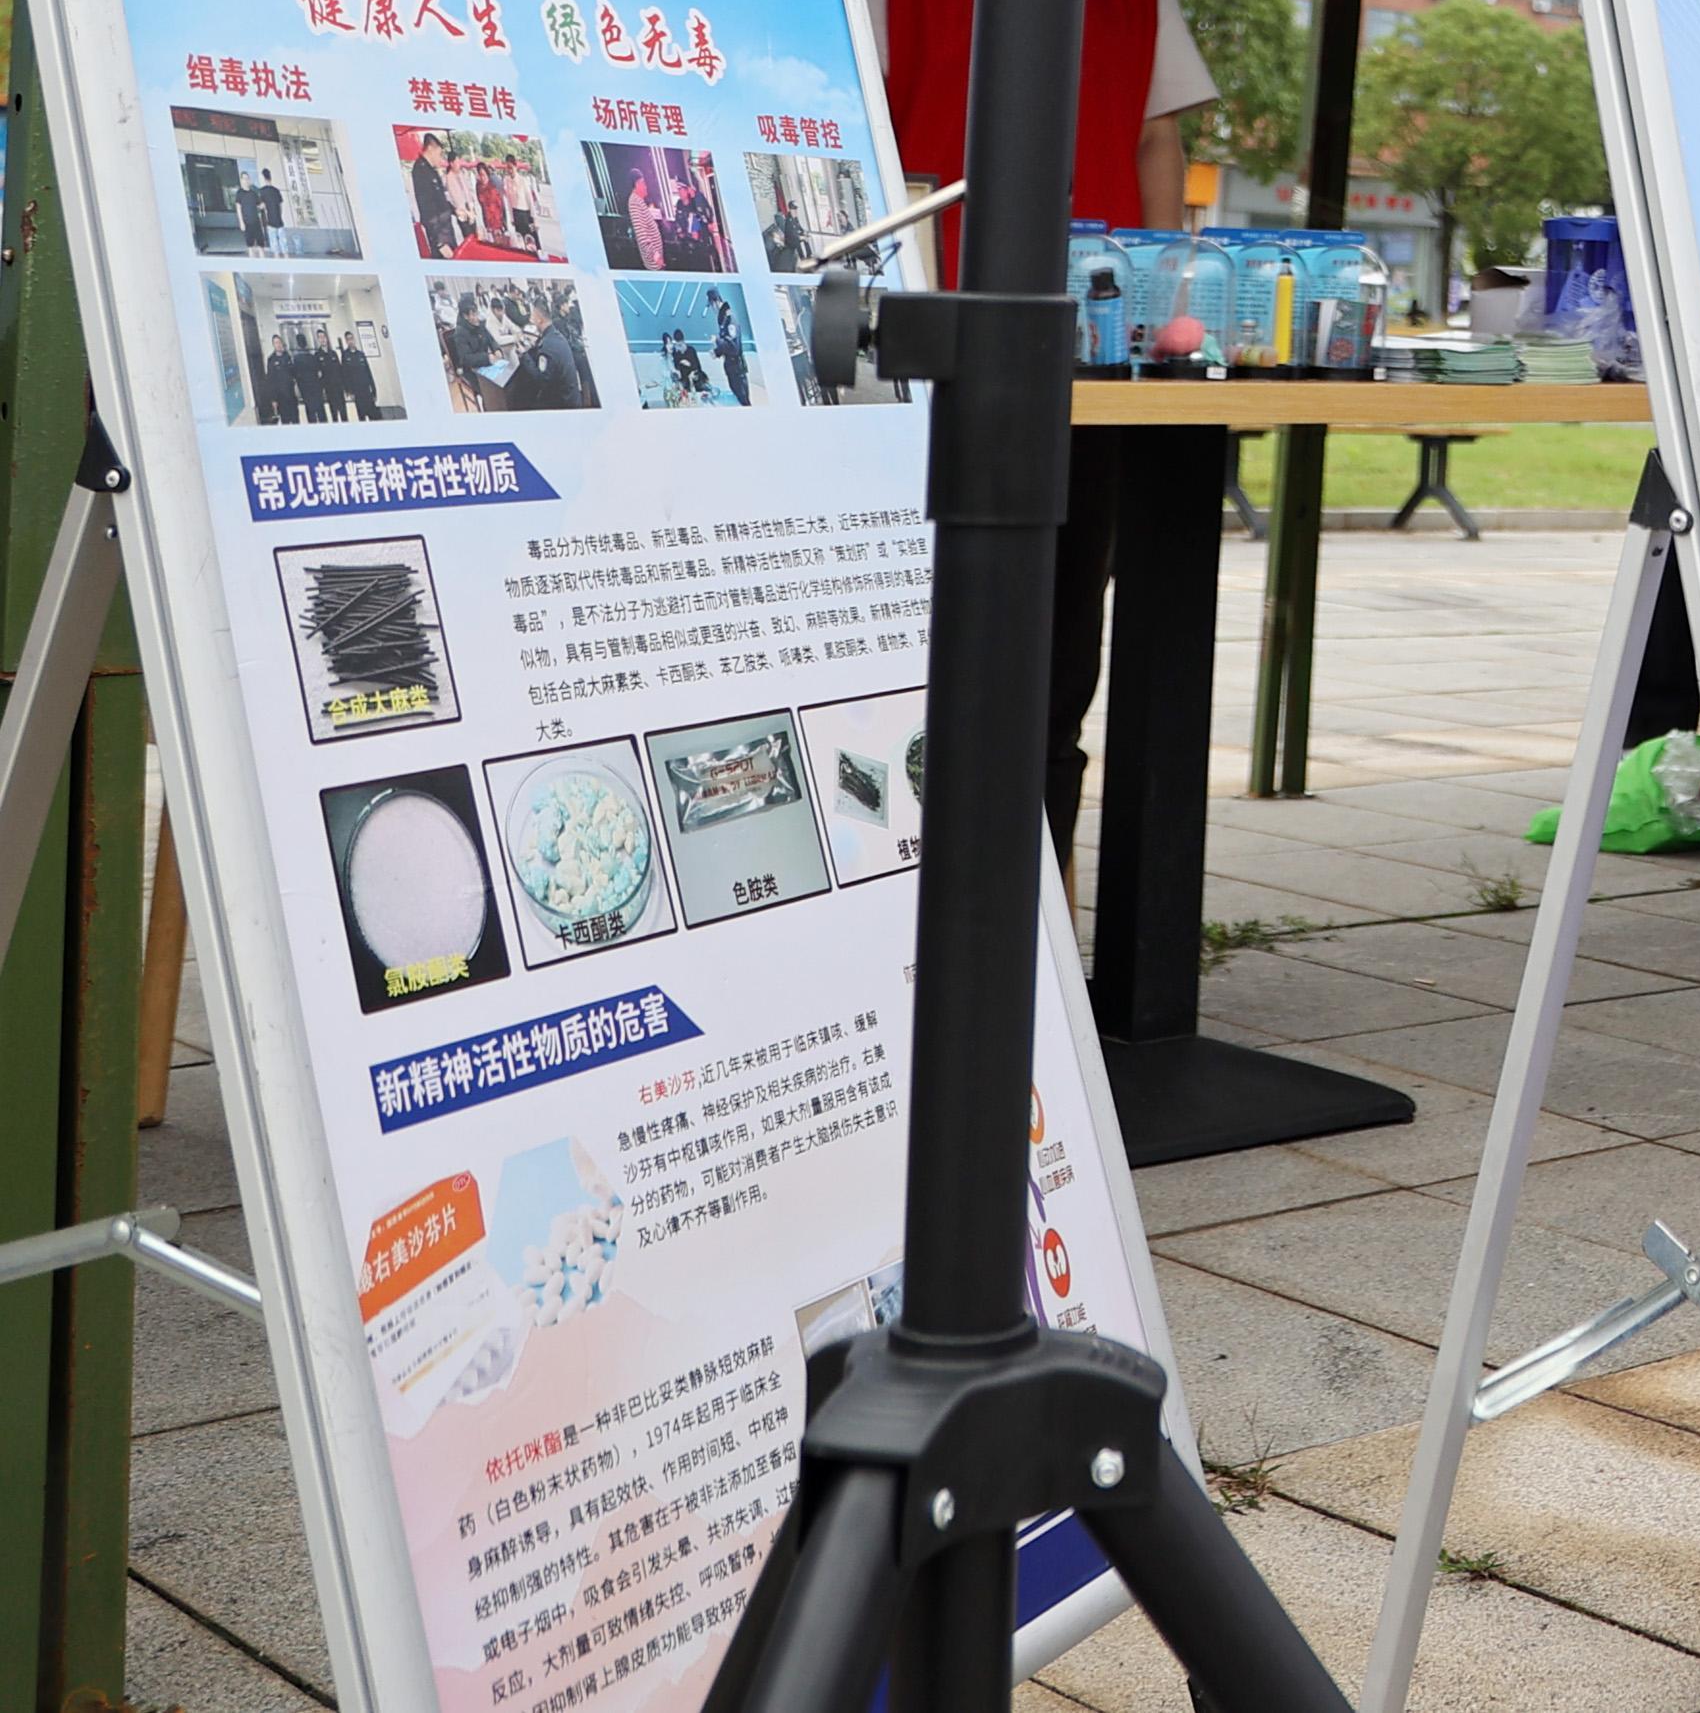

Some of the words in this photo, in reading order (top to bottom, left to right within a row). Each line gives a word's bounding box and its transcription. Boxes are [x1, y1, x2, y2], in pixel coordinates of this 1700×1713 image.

[186, 53, 312, 103] 缉毒执法
[409, 77, 518, 122] 禁毒宣传
[592, 95, 689, 139] 场所管理
[756, 114, 844, 152] 吸毒管控
[251, 452, 521, 512] 常见新精神活性物质
[328, 685, 431, 726] 合成大麻类
[732, 873, 779, 906] 色胺类
[554, 911, 628, 949] 卡西酮类
[383, 954, 470, 998] 氯胺酮类
[375, 992, 672, 1118] 新精神活性物质的危害
[617, 1043, 887, 1152] 急慢性疼痛、神经保护及相关疾病的治疗。右美
[623, 1071, 893, 1185] 沙芬有中枢镇咳作用，如果大剂量服用含有该成
[631, 1099, 899, 1217] 分的药物，可能对消费者产生大脑损伤失去意识
[637, 1184, 770, 1250] 及心律不齐等副作用。
[485, 1334, 776, 1485] 依托咪酯是一种非巴比妥类静脉短效麻醉
[468, 1406, 790, 1582] 身麻醉诱导，具有起效快、作用时间短、中枢神
[475, 1440, 798, 1623] 经抑制强的特性。其危害在于被非法添加至香烟
